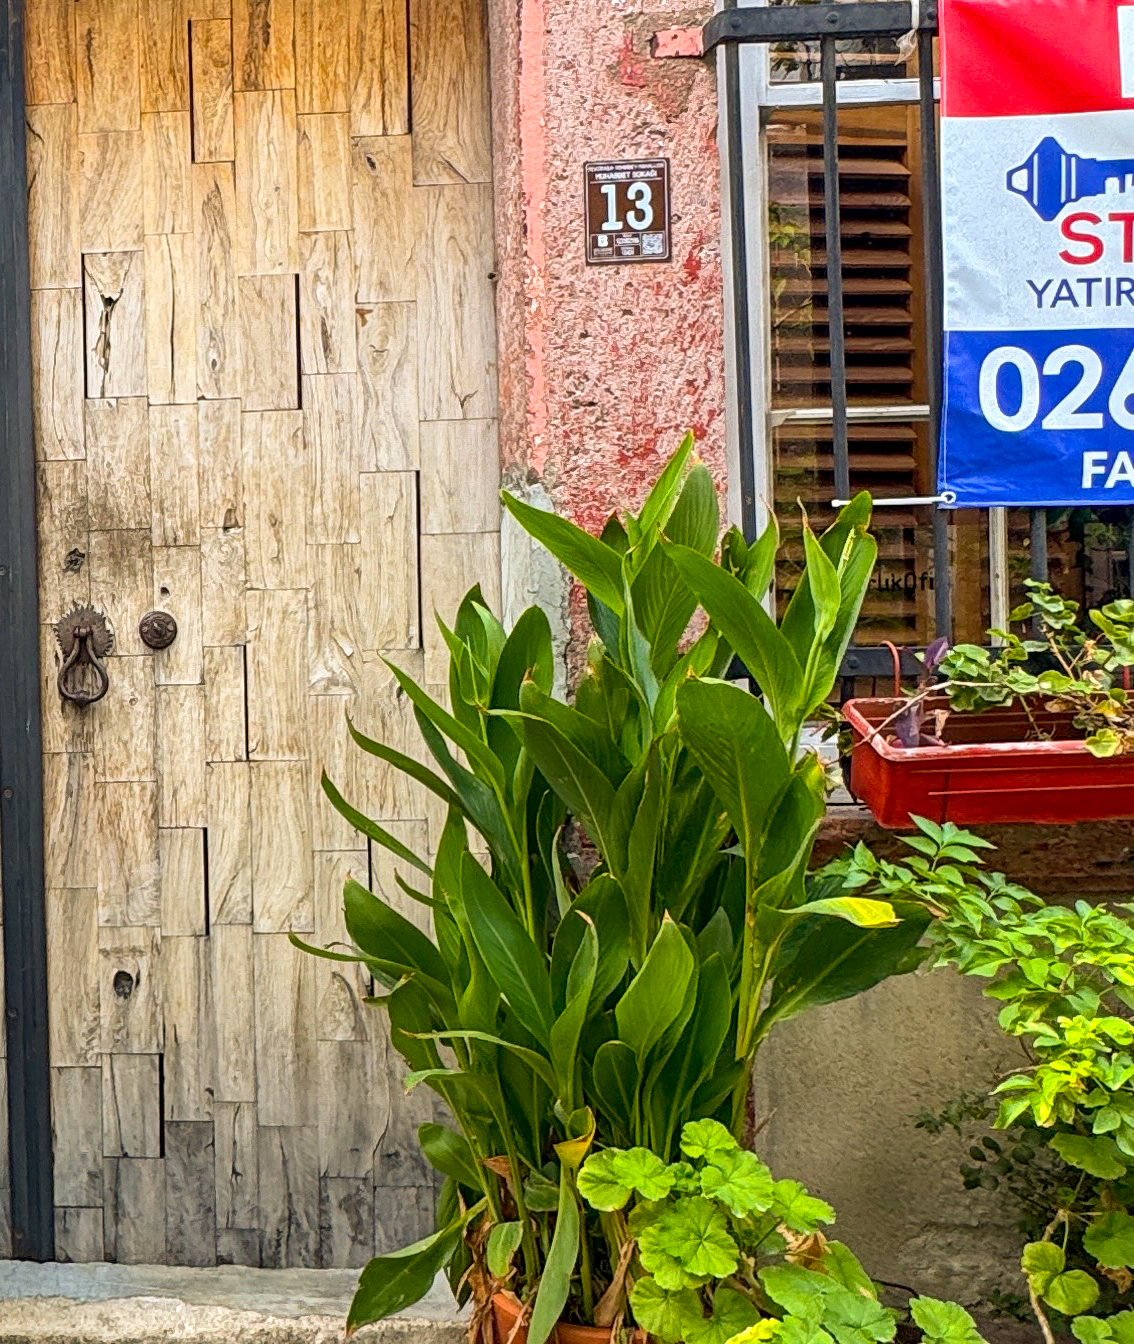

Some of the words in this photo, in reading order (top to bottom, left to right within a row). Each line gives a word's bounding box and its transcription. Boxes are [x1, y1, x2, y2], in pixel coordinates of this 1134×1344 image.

[600, 181, 654, 231] 13
[1058, 211, 1134, 265] ST
[1026, 277, 1134, 309] YATIR
